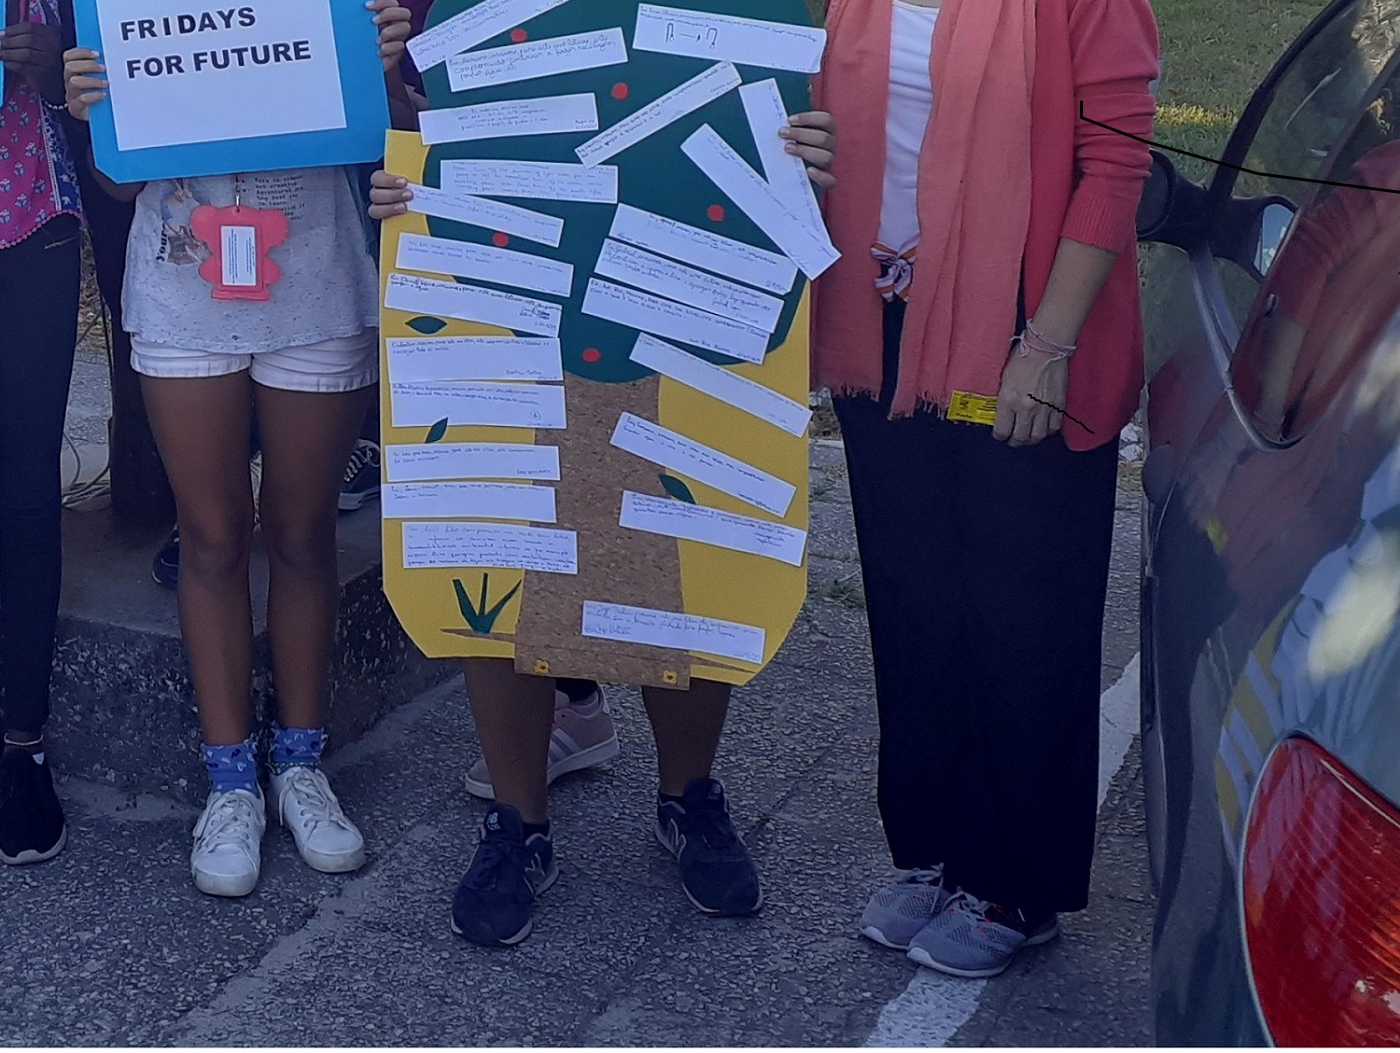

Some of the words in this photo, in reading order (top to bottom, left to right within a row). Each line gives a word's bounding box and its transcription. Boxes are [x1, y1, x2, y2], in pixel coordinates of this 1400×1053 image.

[120, 6, 256, 41] FRIDAYS
[126, 54, 185, 79] FOR
[192, 40, 312, 72] FUTURE
